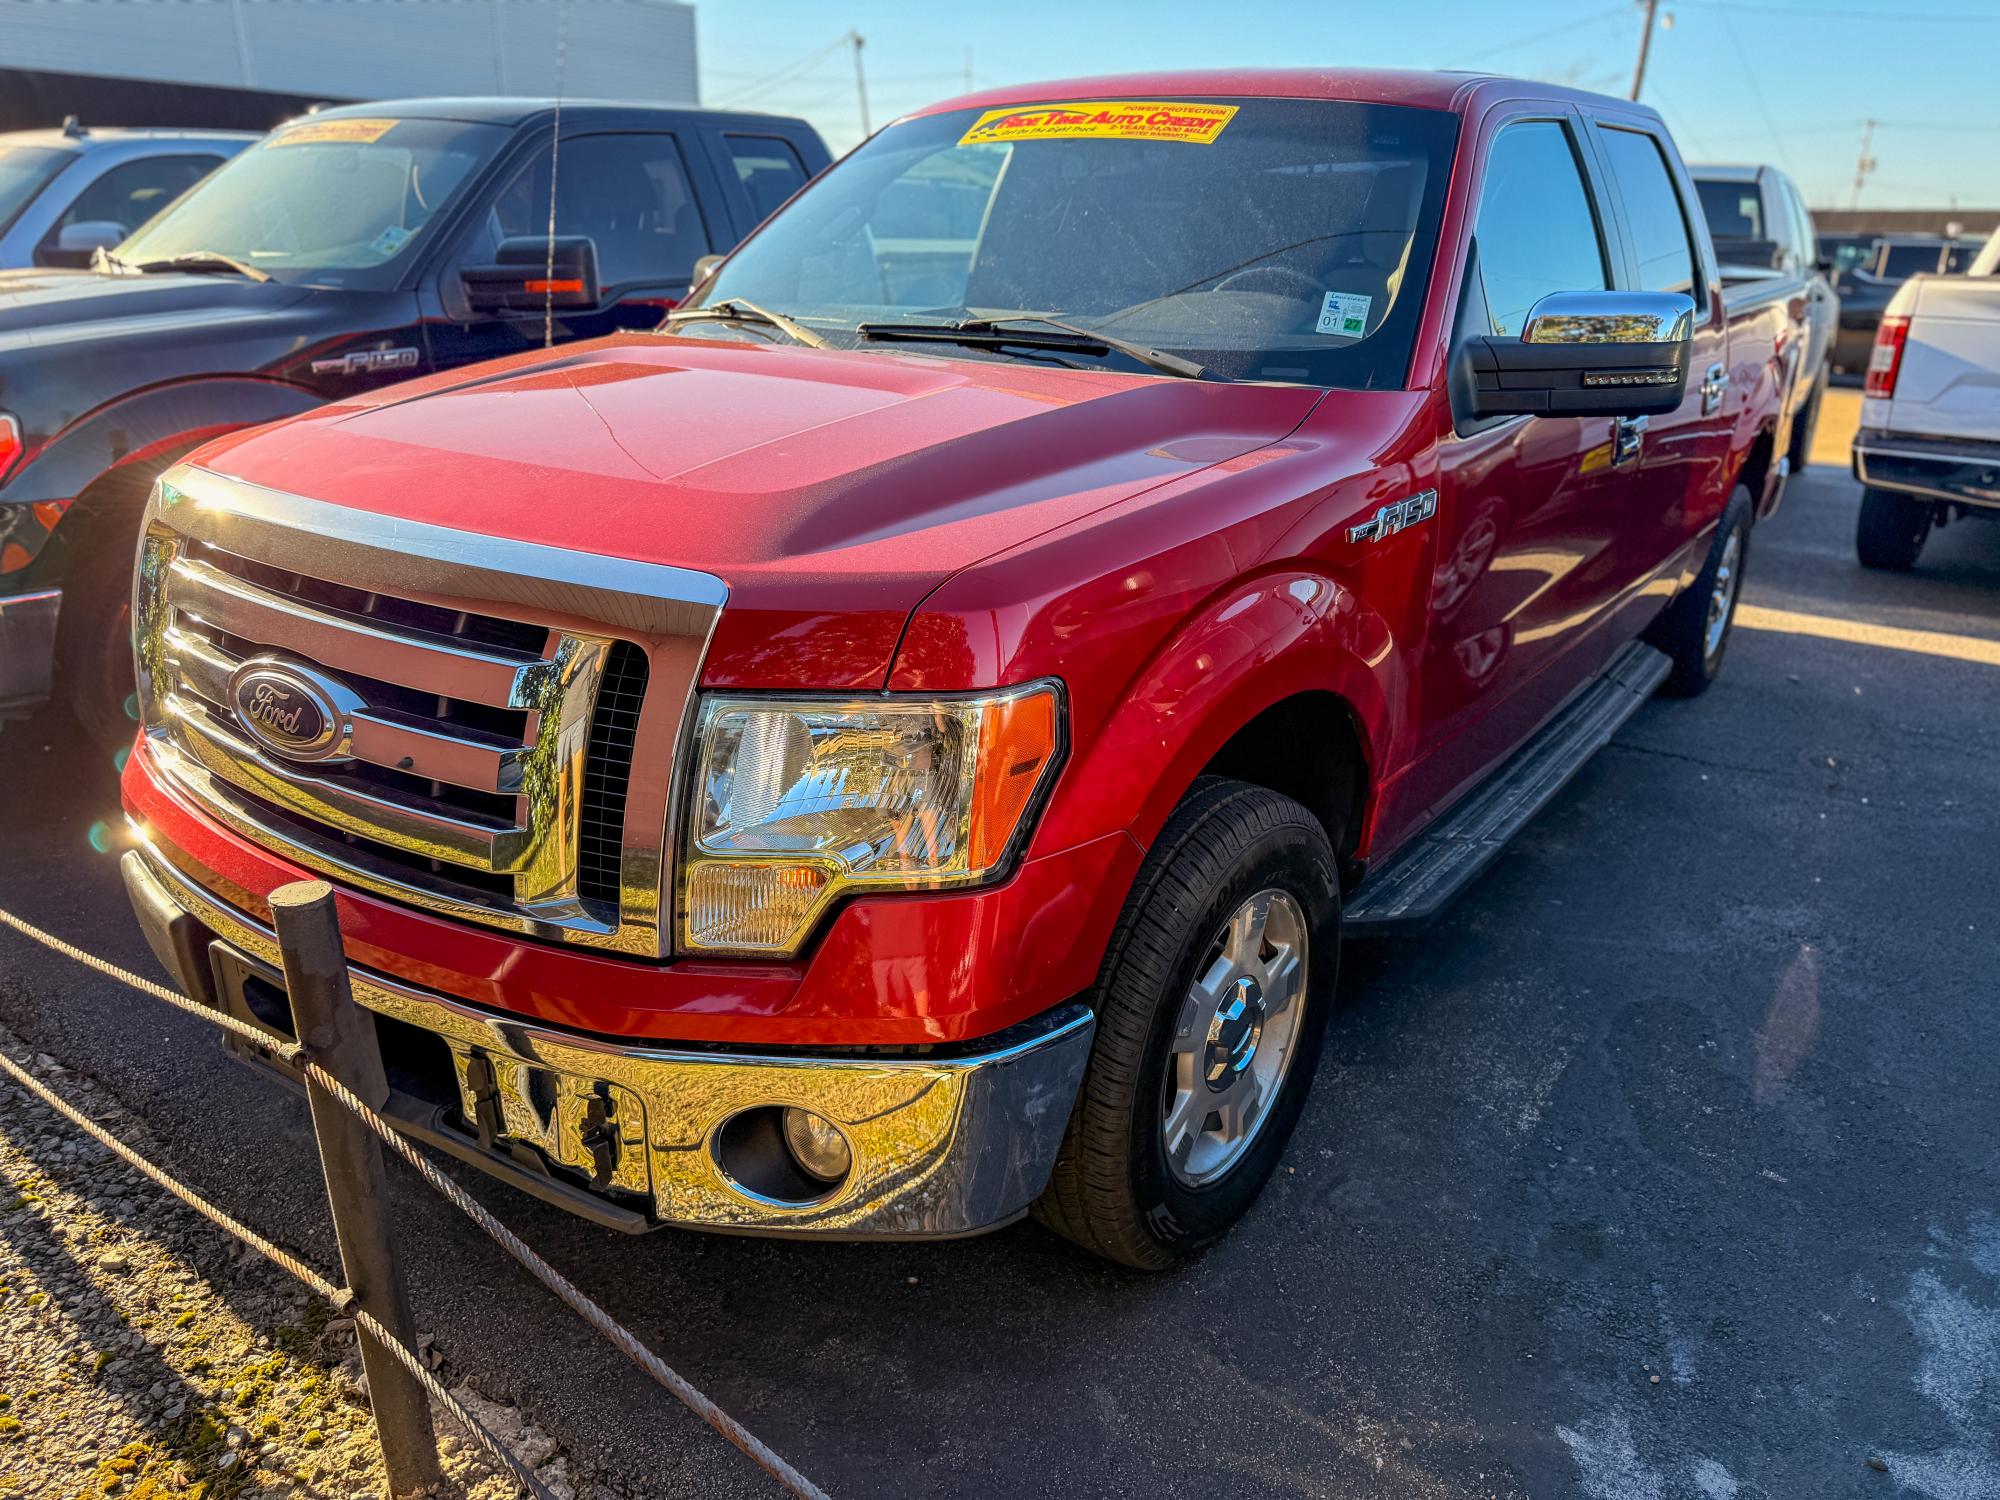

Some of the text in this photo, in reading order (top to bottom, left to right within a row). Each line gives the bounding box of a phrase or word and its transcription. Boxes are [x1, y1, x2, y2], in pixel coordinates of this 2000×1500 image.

[1161, 107, 1227, 115] PROTECTION
[1087, 111, 1144, 124] AUTO
[1146, 112, 1223, 129] CREDIT
[1184, 127, 1211, 135] MILE
[1323, 316, 1338, 327] 01
[1344, 318, 1361, 330] 27
[249, 683, 303, 734] Ford
